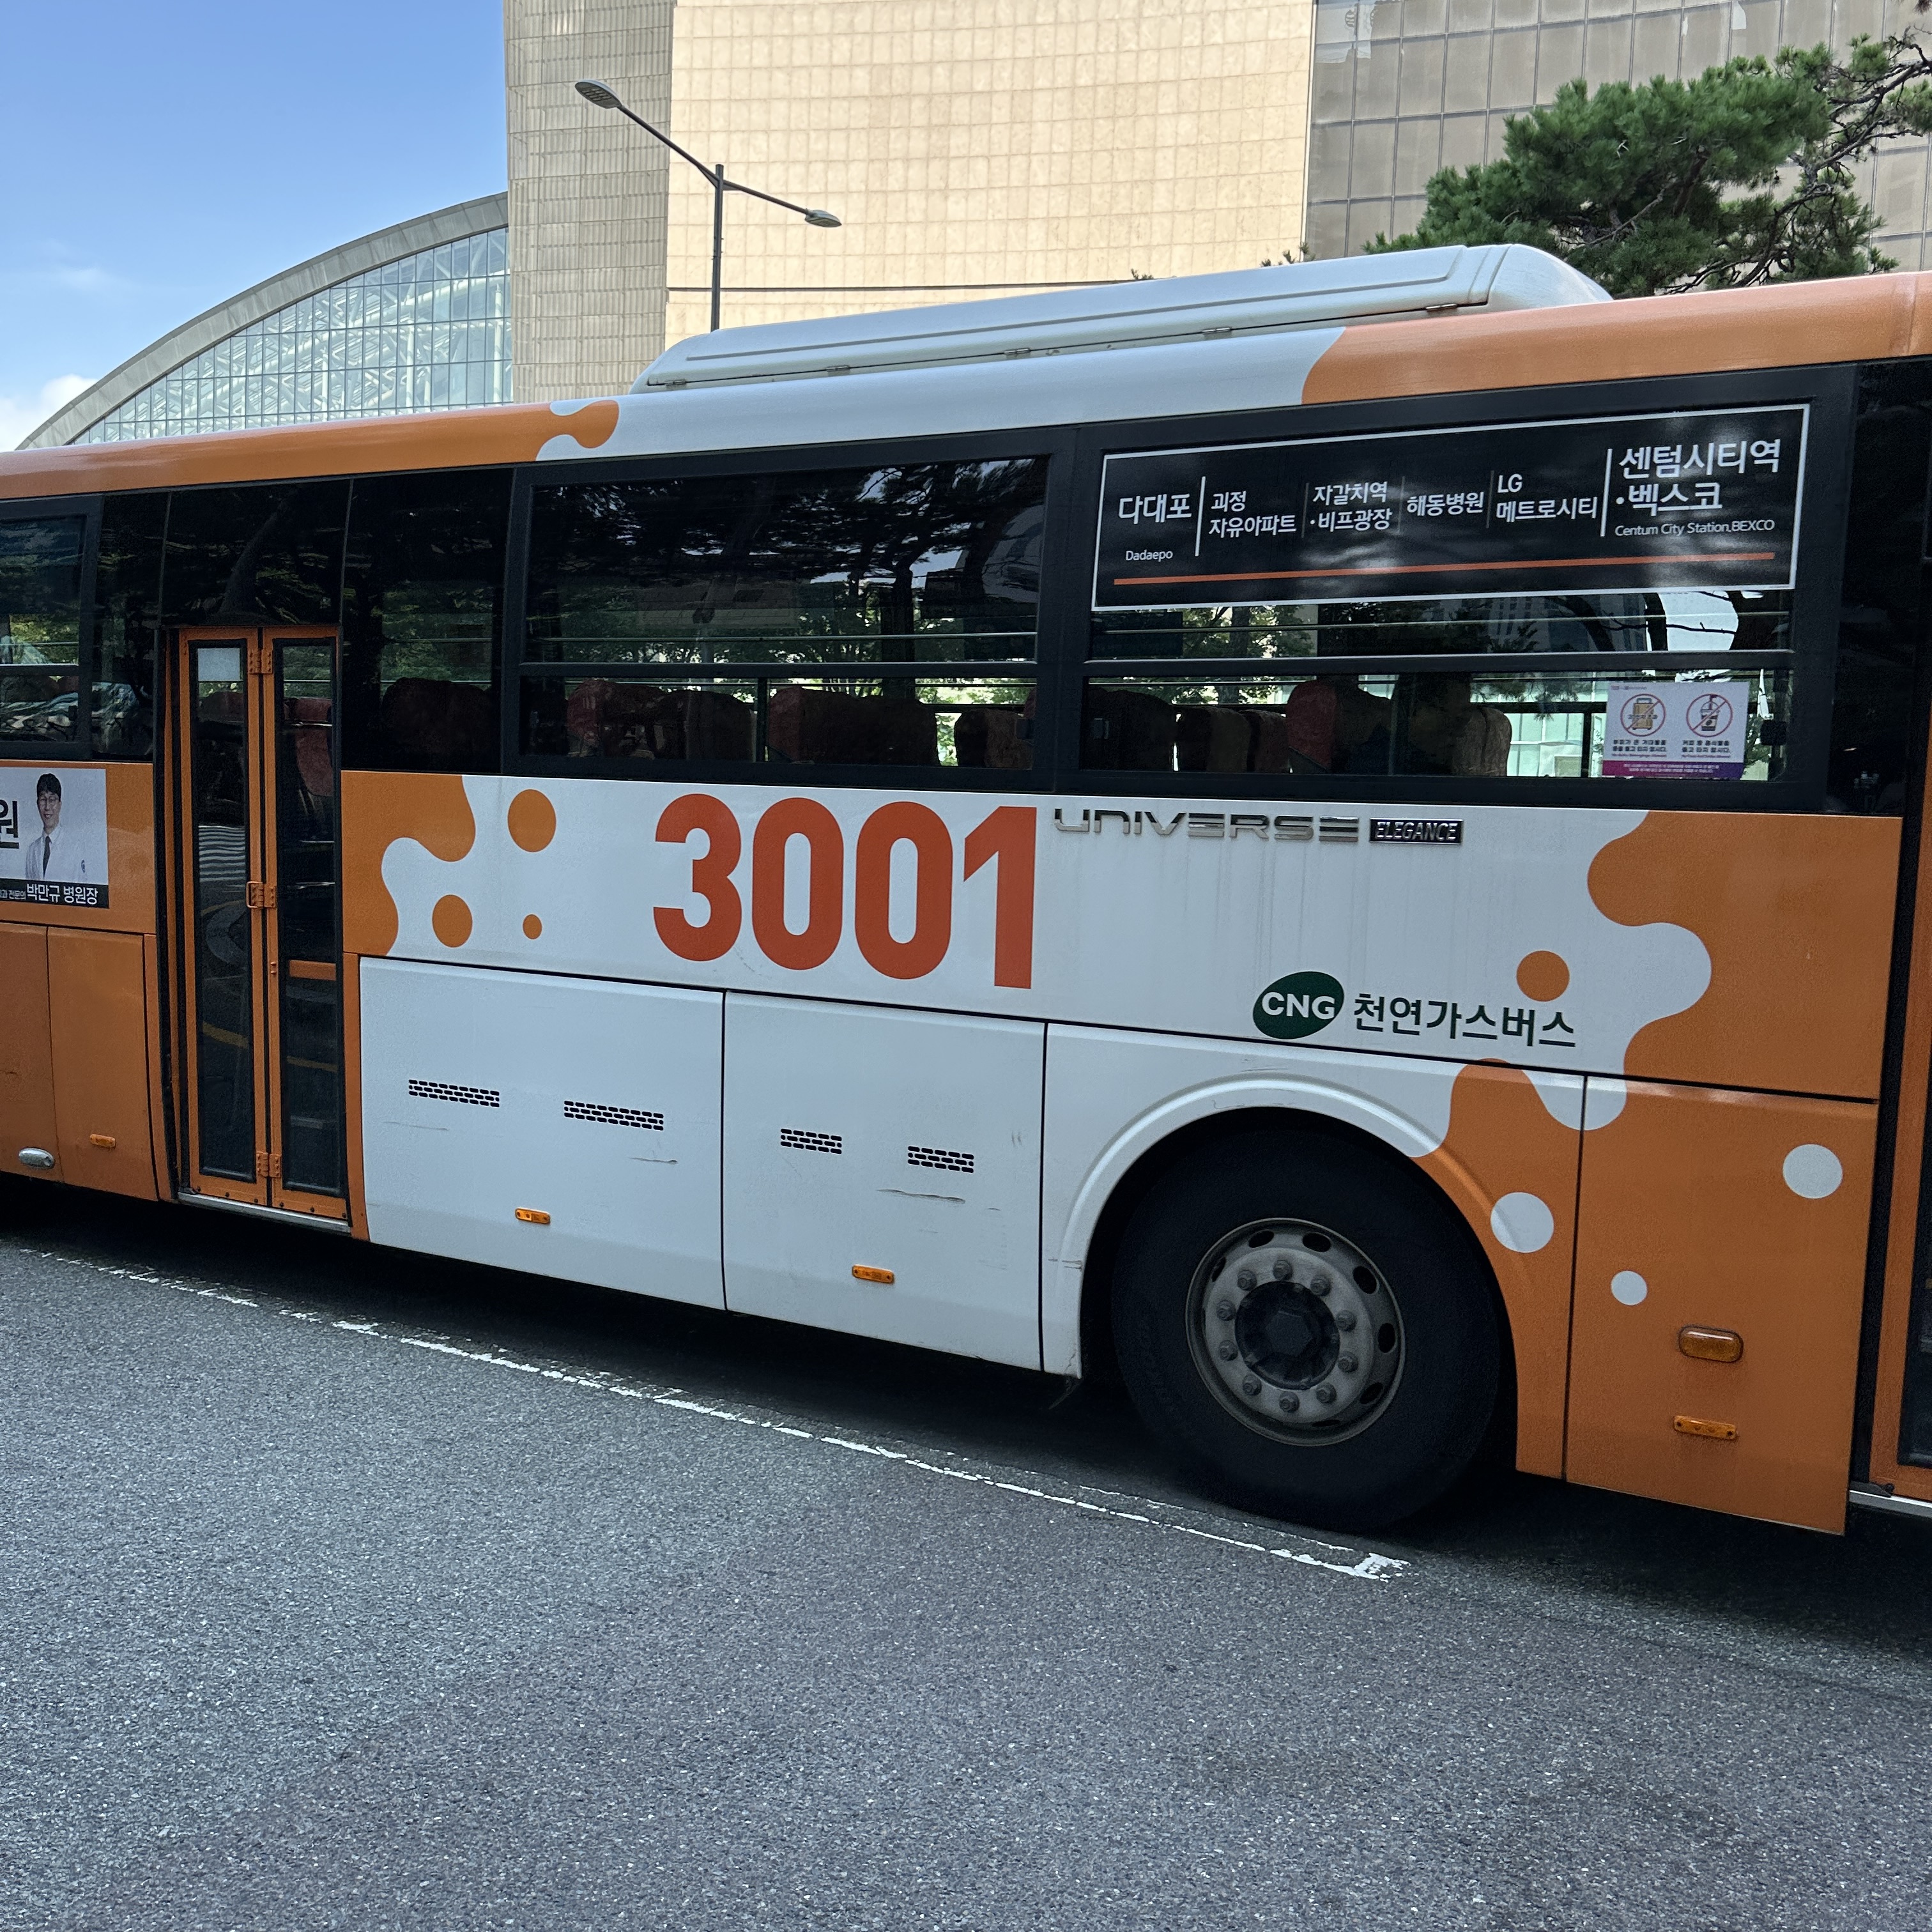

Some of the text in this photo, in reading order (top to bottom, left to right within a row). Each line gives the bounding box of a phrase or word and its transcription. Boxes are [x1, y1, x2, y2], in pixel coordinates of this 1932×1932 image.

[1618, 438, 1781, 480] 센텀시티역
[1312, 480, 1388, 506] 자갈치역
[1497, 473, 1523, 494] LG
[1118, 493, 1192, 525] 다대포
[1210, 490, 1247, 512] 괴정
[1406, 491, 1485, 518] 해동병원
[1496, 496, 1598, 523] 메트로시티
[1208, 513, 1298, 539] 자유아파트
[1614, 525, 1659, 537] Centum
[1661, 523, 1685, 537] City
[1125, 548, 1174, 562] Dadaepo
[1054, 808, 1458, 843] UNIVERSE ELEGANCE
[26, 884, 61, 903] 박만규
[63, 885, 98, 905] 병원장
[653, 793, 1038, 990] 3001
[1261, 991, 1335, 1020] CNG
[1353, 992, 1576, 1048] 천연가스버스
